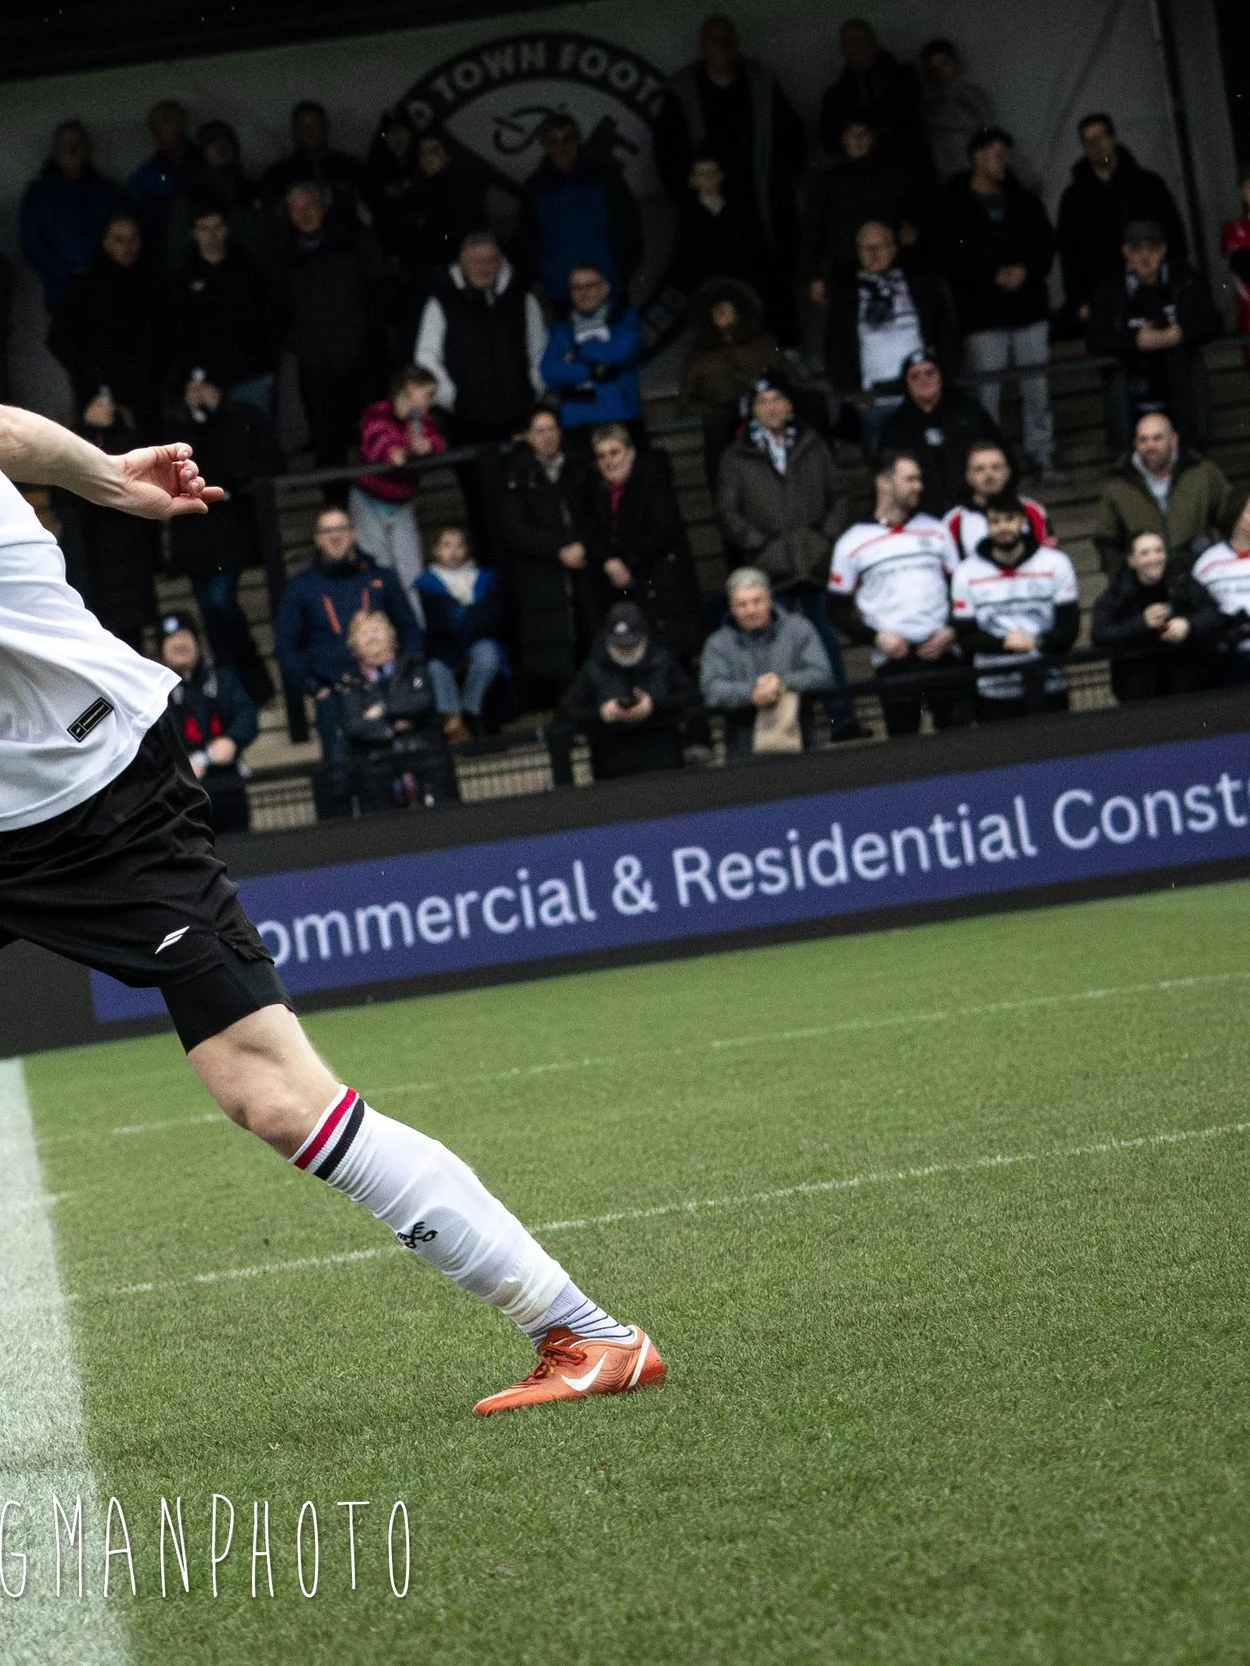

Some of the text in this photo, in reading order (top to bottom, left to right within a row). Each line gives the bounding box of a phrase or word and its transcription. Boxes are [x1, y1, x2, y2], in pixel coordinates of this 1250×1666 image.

[427, 41, 548, 102] TOWN
[257, 771, 1250, 968] ommercial & Residential Const
